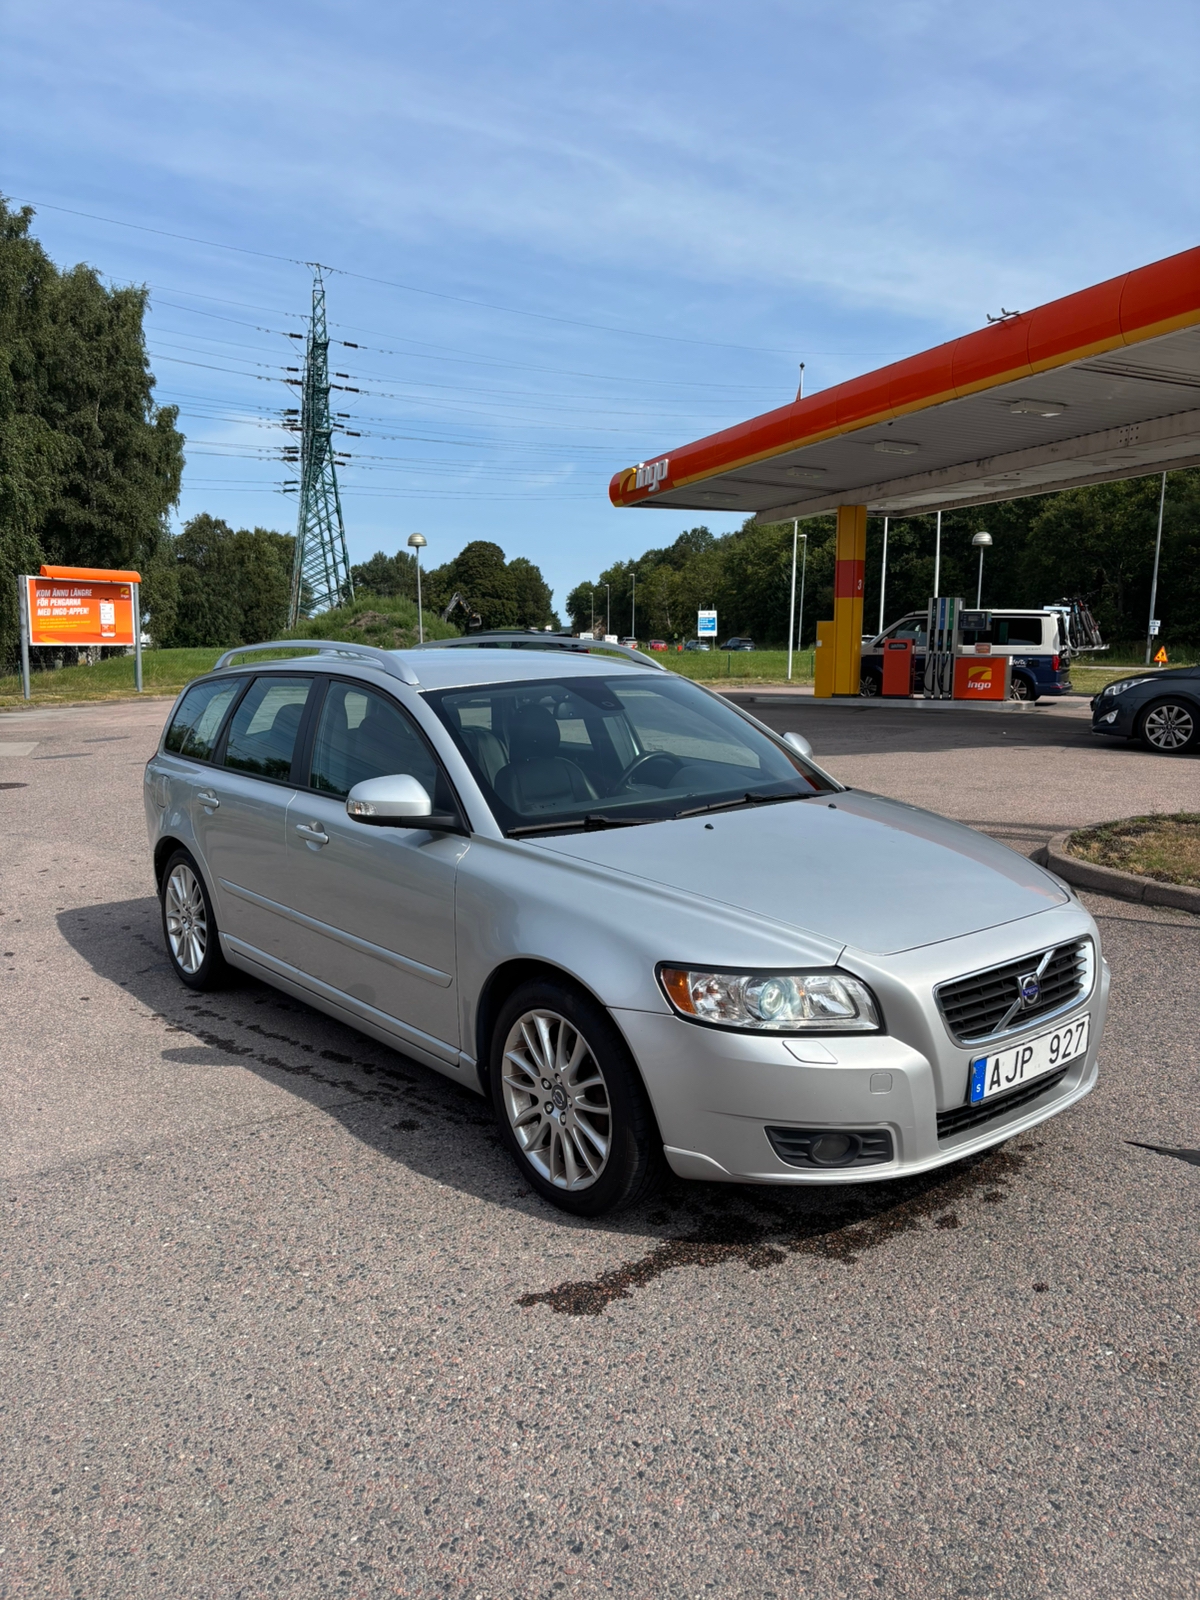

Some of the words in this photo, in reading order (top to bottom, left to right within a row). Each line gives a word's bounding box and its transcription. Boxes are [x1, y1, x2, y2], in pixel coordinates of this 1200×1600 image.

[636, 459, 669, 492] ingo
[857, 579, 863, 591] 3
[36, 589, 51, 597] KOM
[52, 588, 70, 597] ÄNNU
[70, 588, 93, 597] LÄNGRE
[36, 598, 49, 607] FÖR
[50, 598, 82, 607] PENGARNA
[37, 607, 51, 616] MED
[967, 680, 992, 691] ingo
[988, 1045, 1034, 1091] AJP
[1048, 1021, 1086, 1065] 927
[976, 1083, 982, 1093] S
